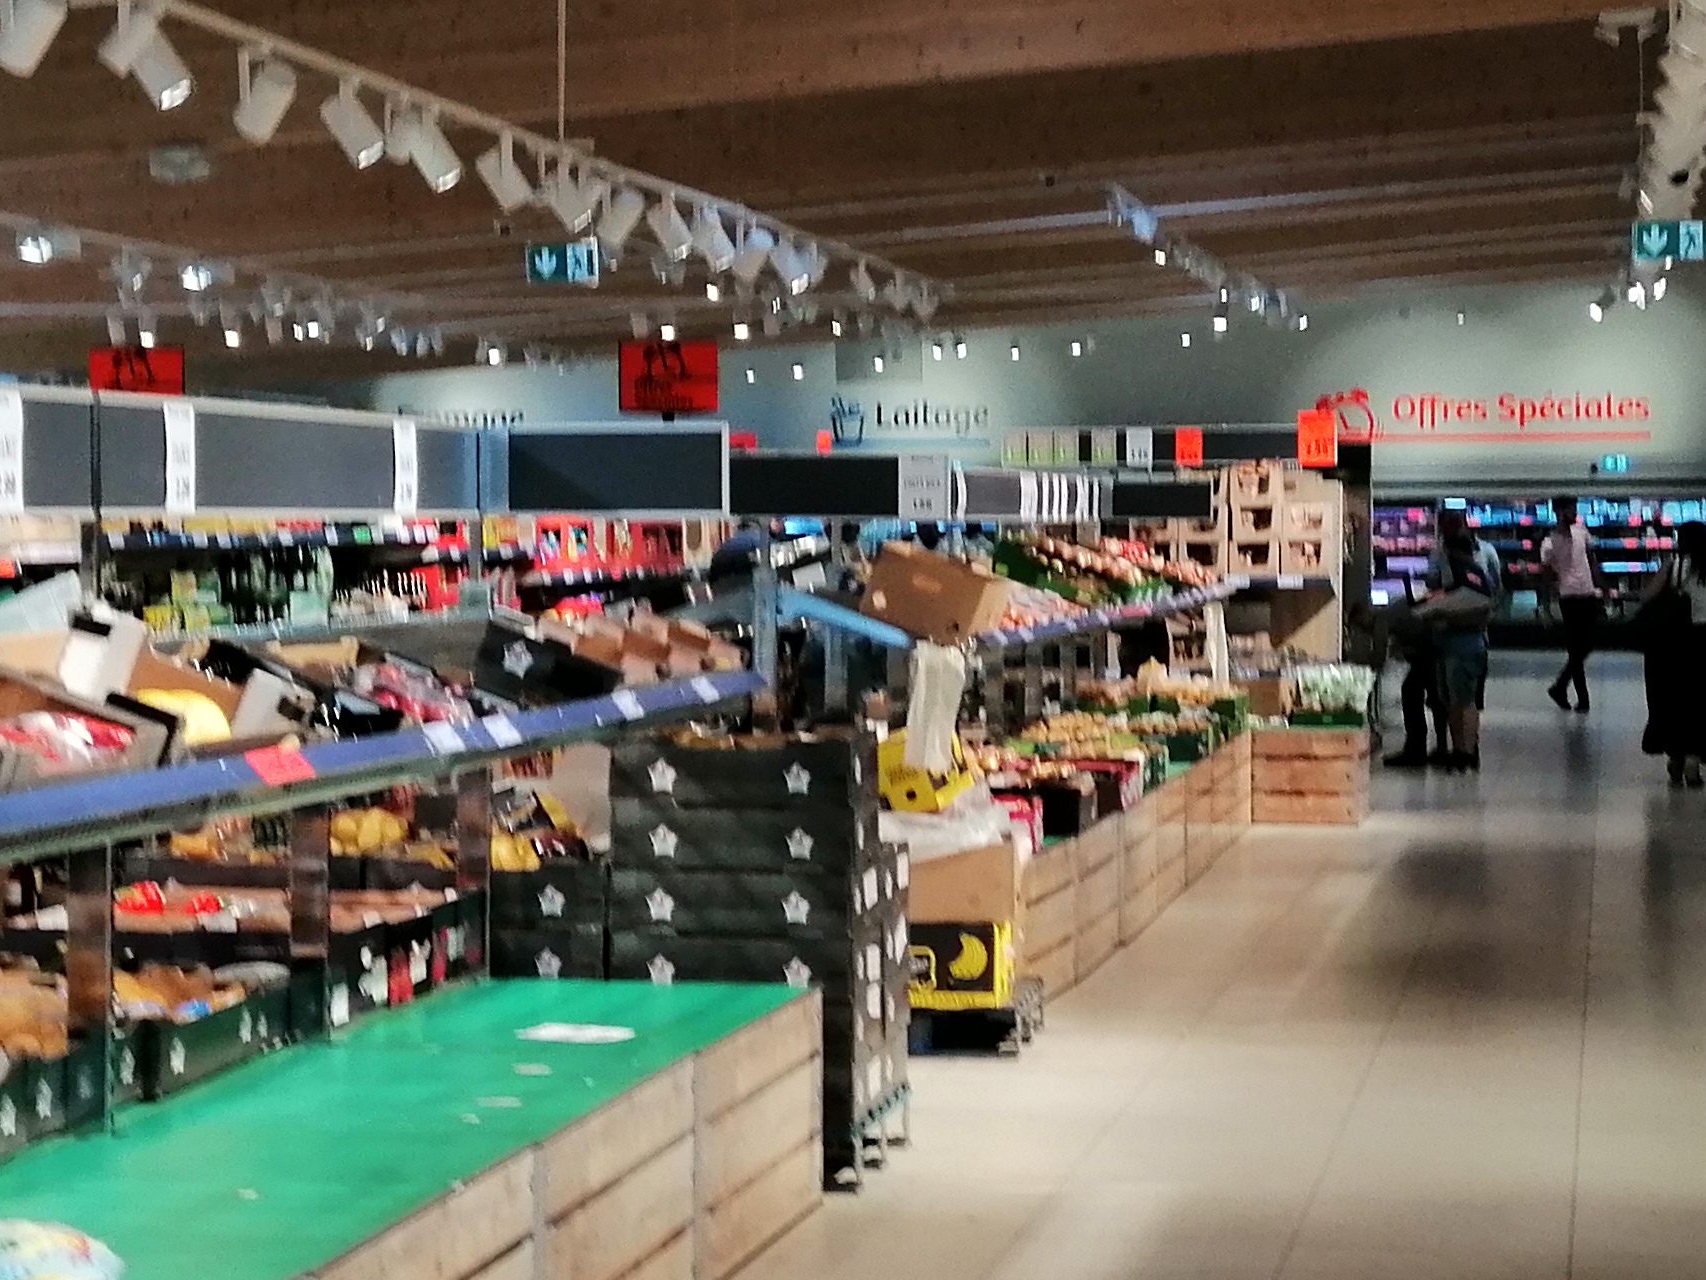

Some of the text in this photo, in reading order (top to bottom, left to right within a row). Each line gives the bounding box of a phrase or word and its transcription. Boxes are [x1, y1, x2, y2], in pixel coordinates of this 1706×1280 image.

[876, 400, 989, 436] Laitage
[1393, 391, 1650, 429] Offres Spéciales
